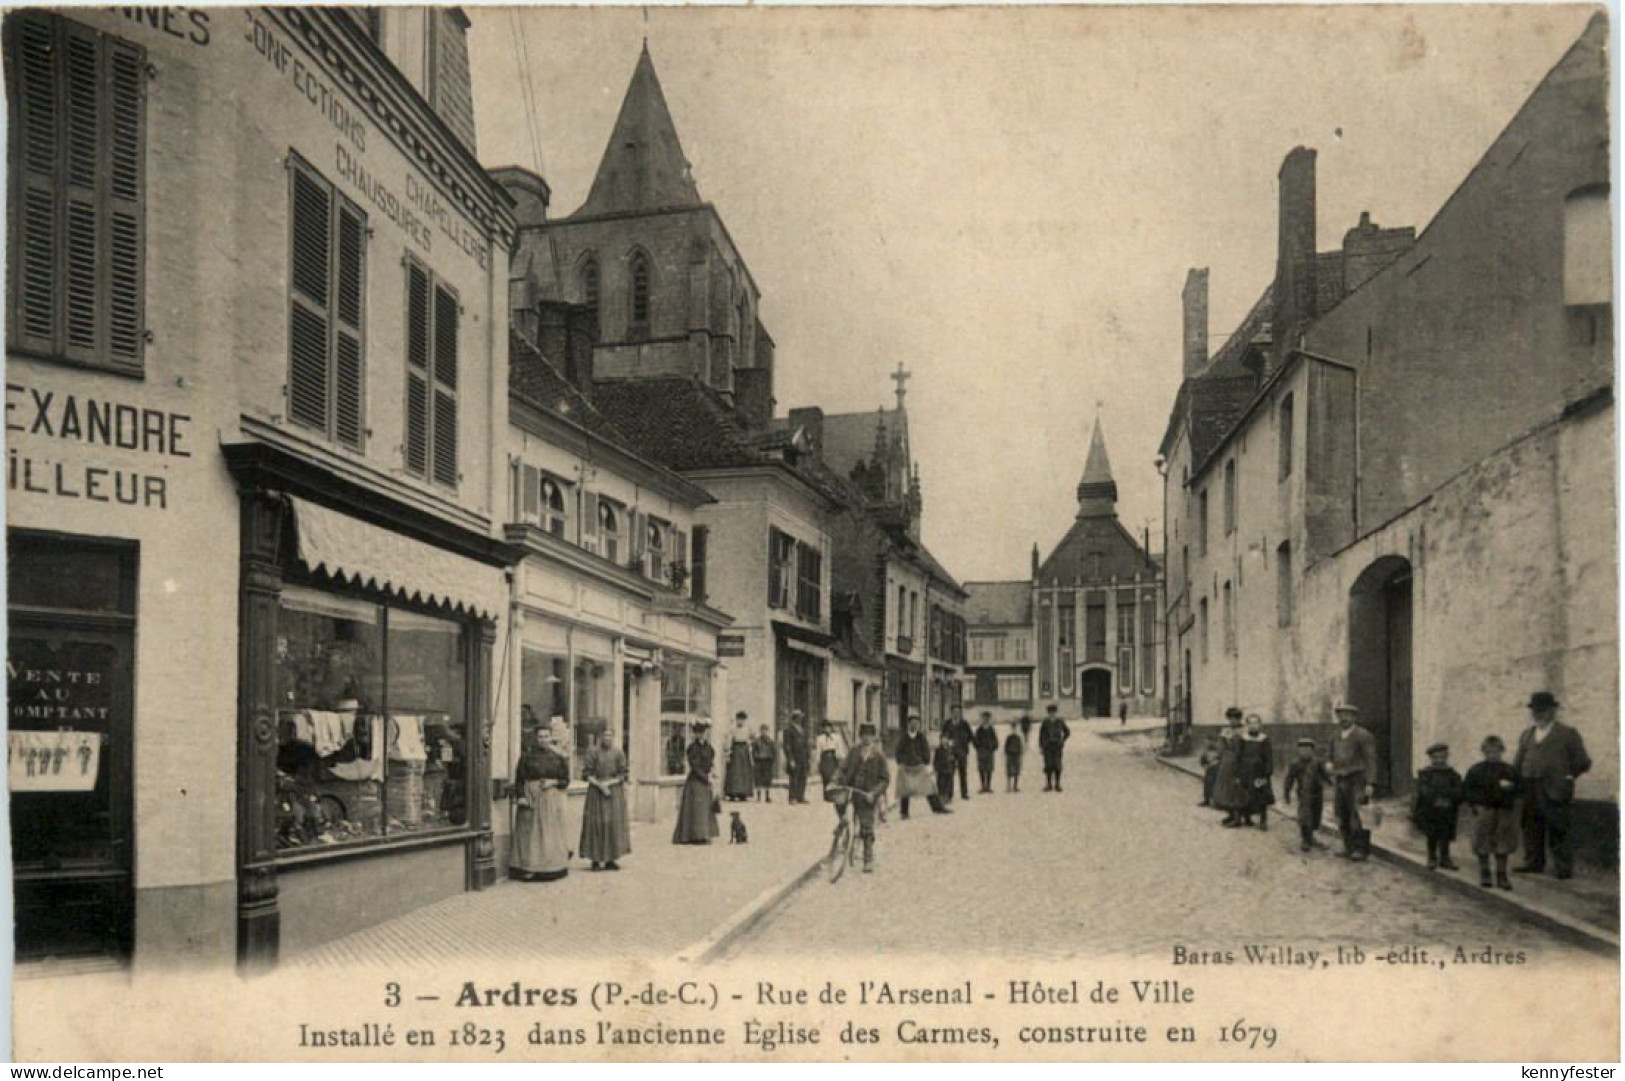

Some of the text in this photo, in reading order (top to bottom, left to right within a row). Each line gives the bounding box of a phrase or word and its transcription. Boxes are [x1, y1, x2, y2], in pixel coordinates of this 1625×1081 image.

[336, 143, 432, 252] CHAUSSURES
[405, 173, 489, 272] CHAPELLERIE
[6, 383, 191, 457] EXANDRE
[6, 660, 101, 684] VENTE
[34, 687, 70, 701] AU
[14, 705, 109, 720] OMPTANT
